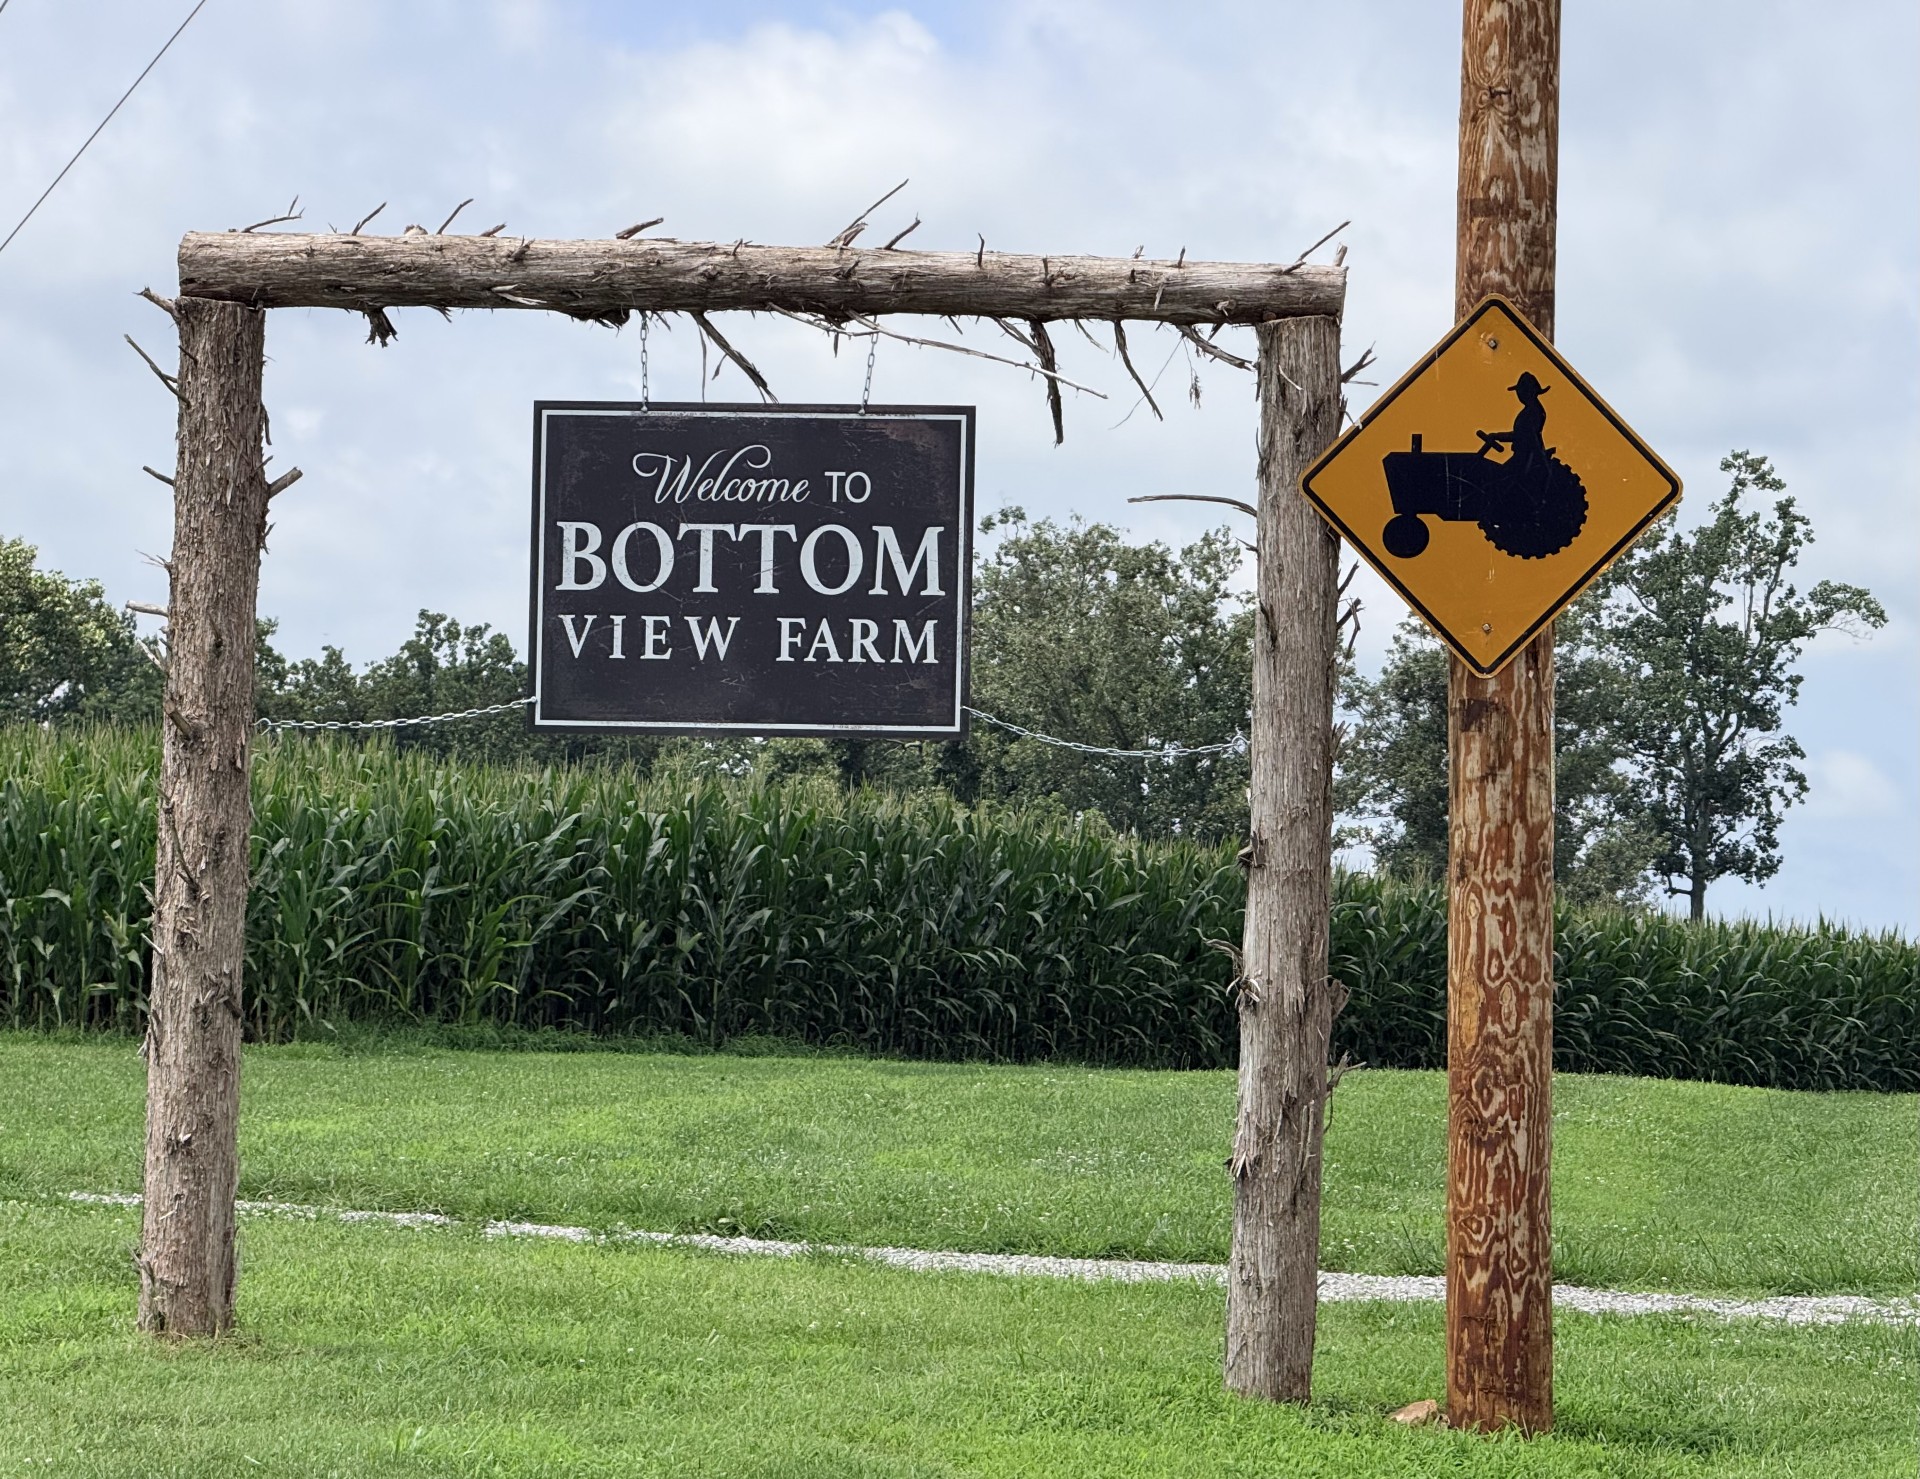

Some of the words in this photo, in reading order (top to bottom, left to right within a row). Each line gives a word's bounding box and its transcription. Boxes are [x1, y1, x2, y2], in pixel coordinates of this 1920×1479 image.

[632, 444, 811, 504] Welcome
[824, 471, 872, 504] TO
[555, 521, 946, 597] BOTTOM
[557, 614, 741, 662] VIEW
[775, 617, 939, 664] FARM
